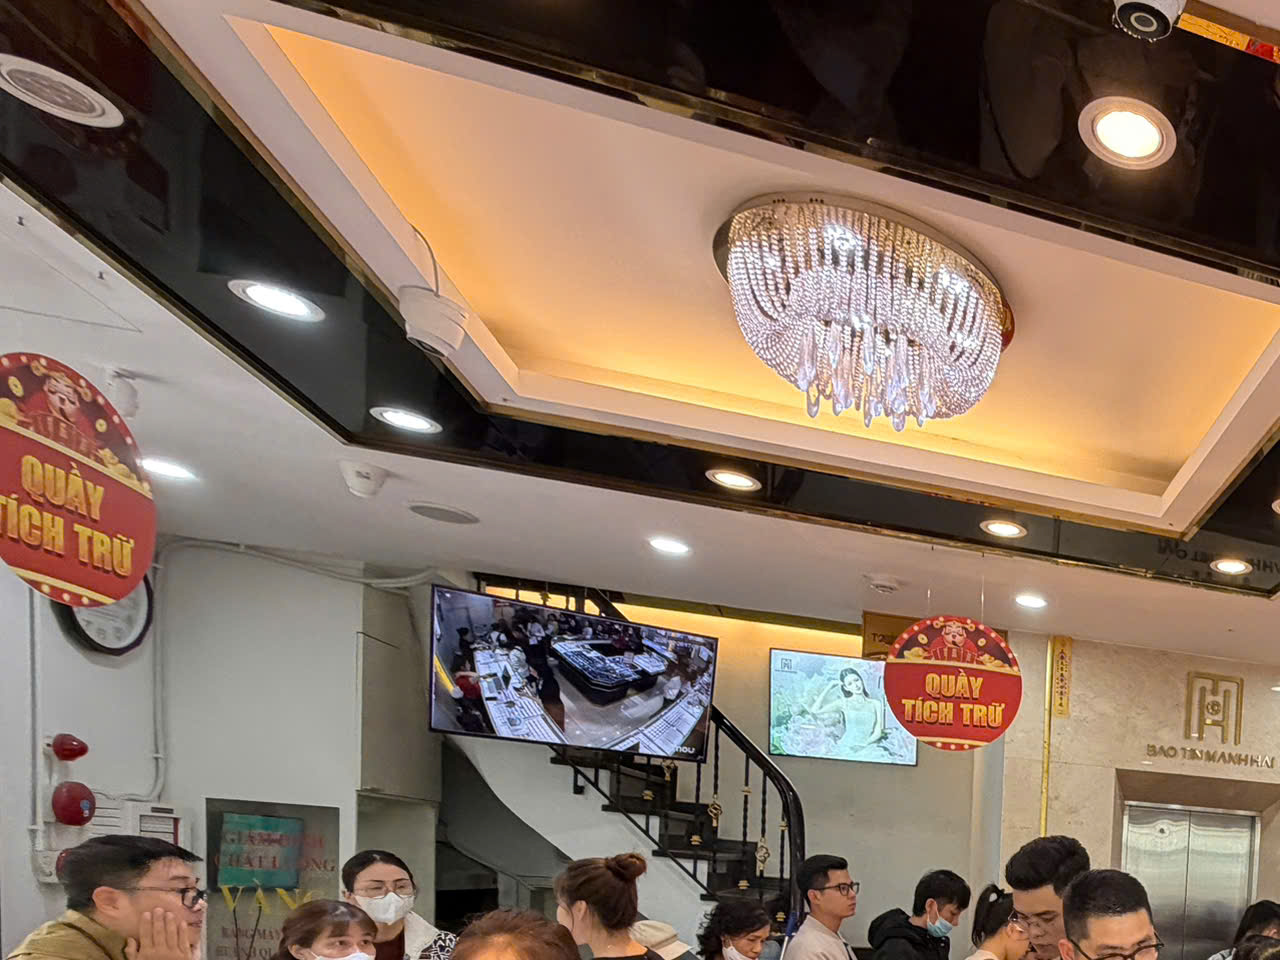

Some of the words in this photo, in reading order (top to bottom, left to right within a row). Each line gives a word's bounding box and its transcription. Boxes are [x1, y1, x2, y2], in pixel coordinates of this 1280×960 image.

[21, 455, 105, 521] QUẦY
[73, 523, 134, 577] TRỮ
[925, 668, 983, 699] QUẦY
[902, 697, 953, 725] TÍCH
[960, 703, 1005, 729] TRỮ
